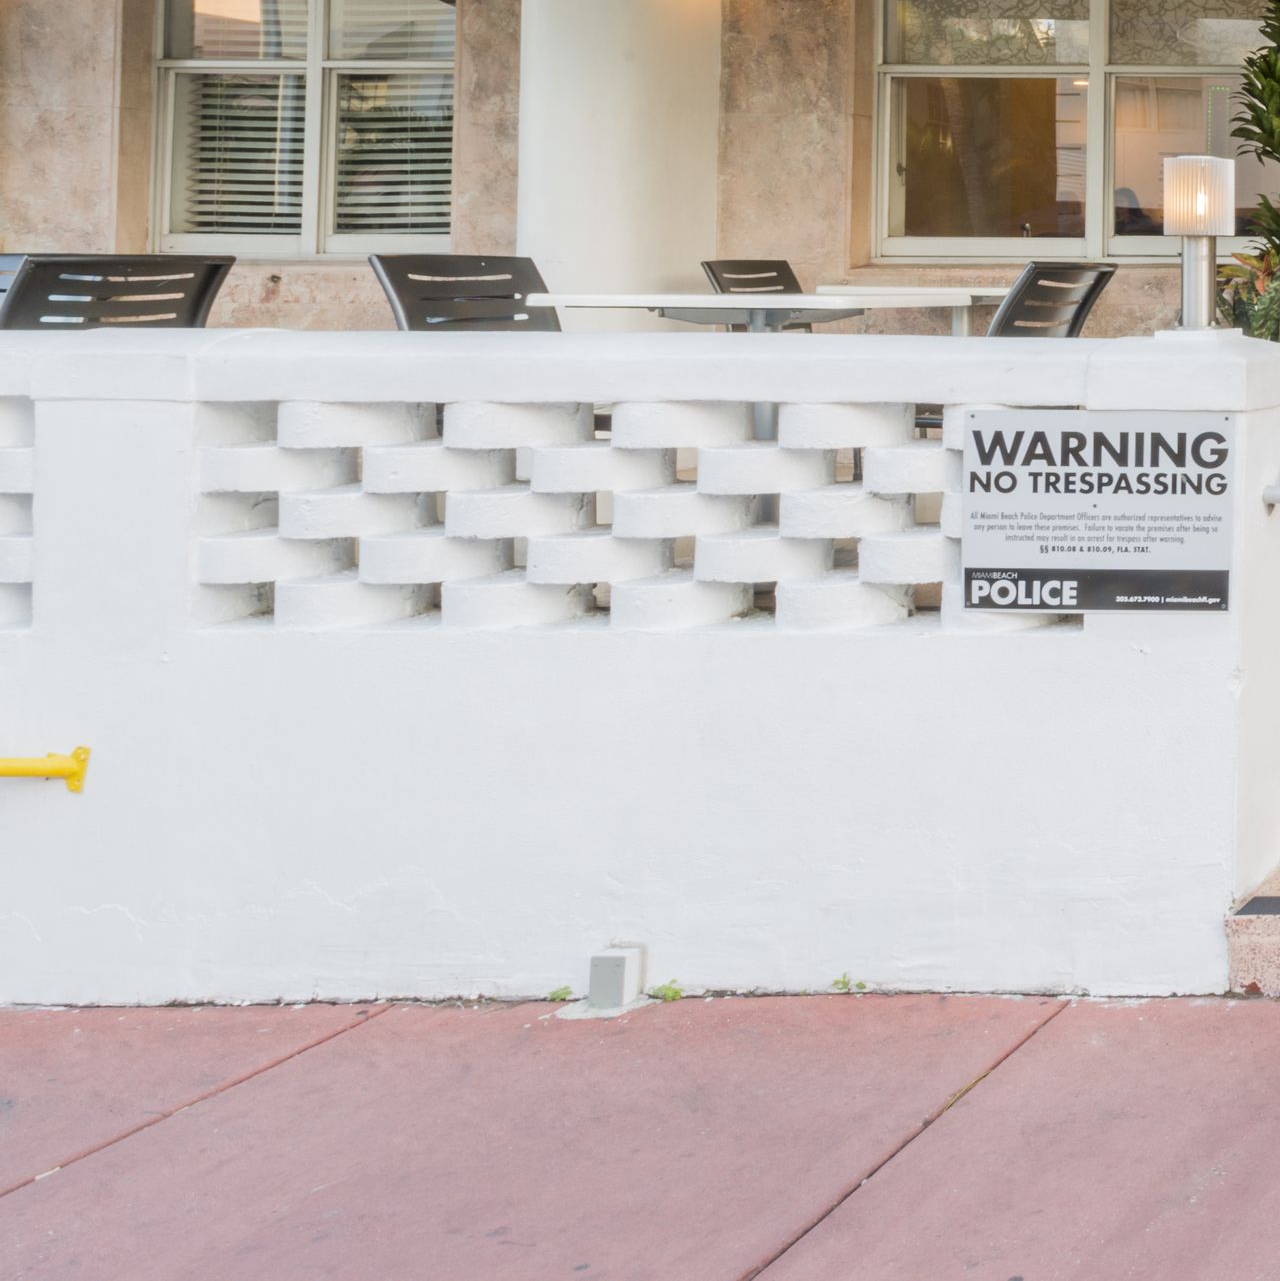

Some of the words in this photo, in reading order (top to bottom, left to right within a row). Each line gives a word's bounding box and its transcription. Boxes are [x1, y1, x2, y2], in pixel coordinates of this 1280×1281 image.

[972, 430, 1229, 469] WARNING
[969, 471, 1018, 494] NO
[1028, 471, 1228, 495] TRESPASSING
[970, 512, 979, 520] All
[980, 512, 999, 520] Miami
[1000, 512, 1018, 520] Beach
[1020, 512, 1037, 520] Police
[1039, 512, 1075, 521] Department
[1077, 512, 1100, 521] Officers
[1113, 513, 1146, 522] authorized
[1147, 514, 1194, 523] representatives
[1195, 514, 1201, 522] to
[1203, 514, 1222, 522] advise
[987, 524, 1007, 532] person
[1009, 523, 1015, 531] to
[1017, 522, 1033, 531] leave
[1034, 523, 1050, 531] these
[1084, 523, 1105, 532] Failure
[1107, 524, 1113, 532] to
[1135, 524, 1145, 532] the
[1147, 524, 1175, 533] premises
[1176, 524, 1190, 532] after
[1192, 524, 1210, 534] being
[1005, 533, 1035, 541] instructed
[1036, 535, 1049, 543] may
[1051, 534, 1068, 542] result
[1069, 534, 1076, 542] in
[1106, 534, 1115, 542] for
[1116, 535, 1141, 544] trespass
[1142, 534, 1157, 543] after
[972, 572, 1018, 580] MIAMIBEACH
[971, 580, 1078, 606] POLICE
